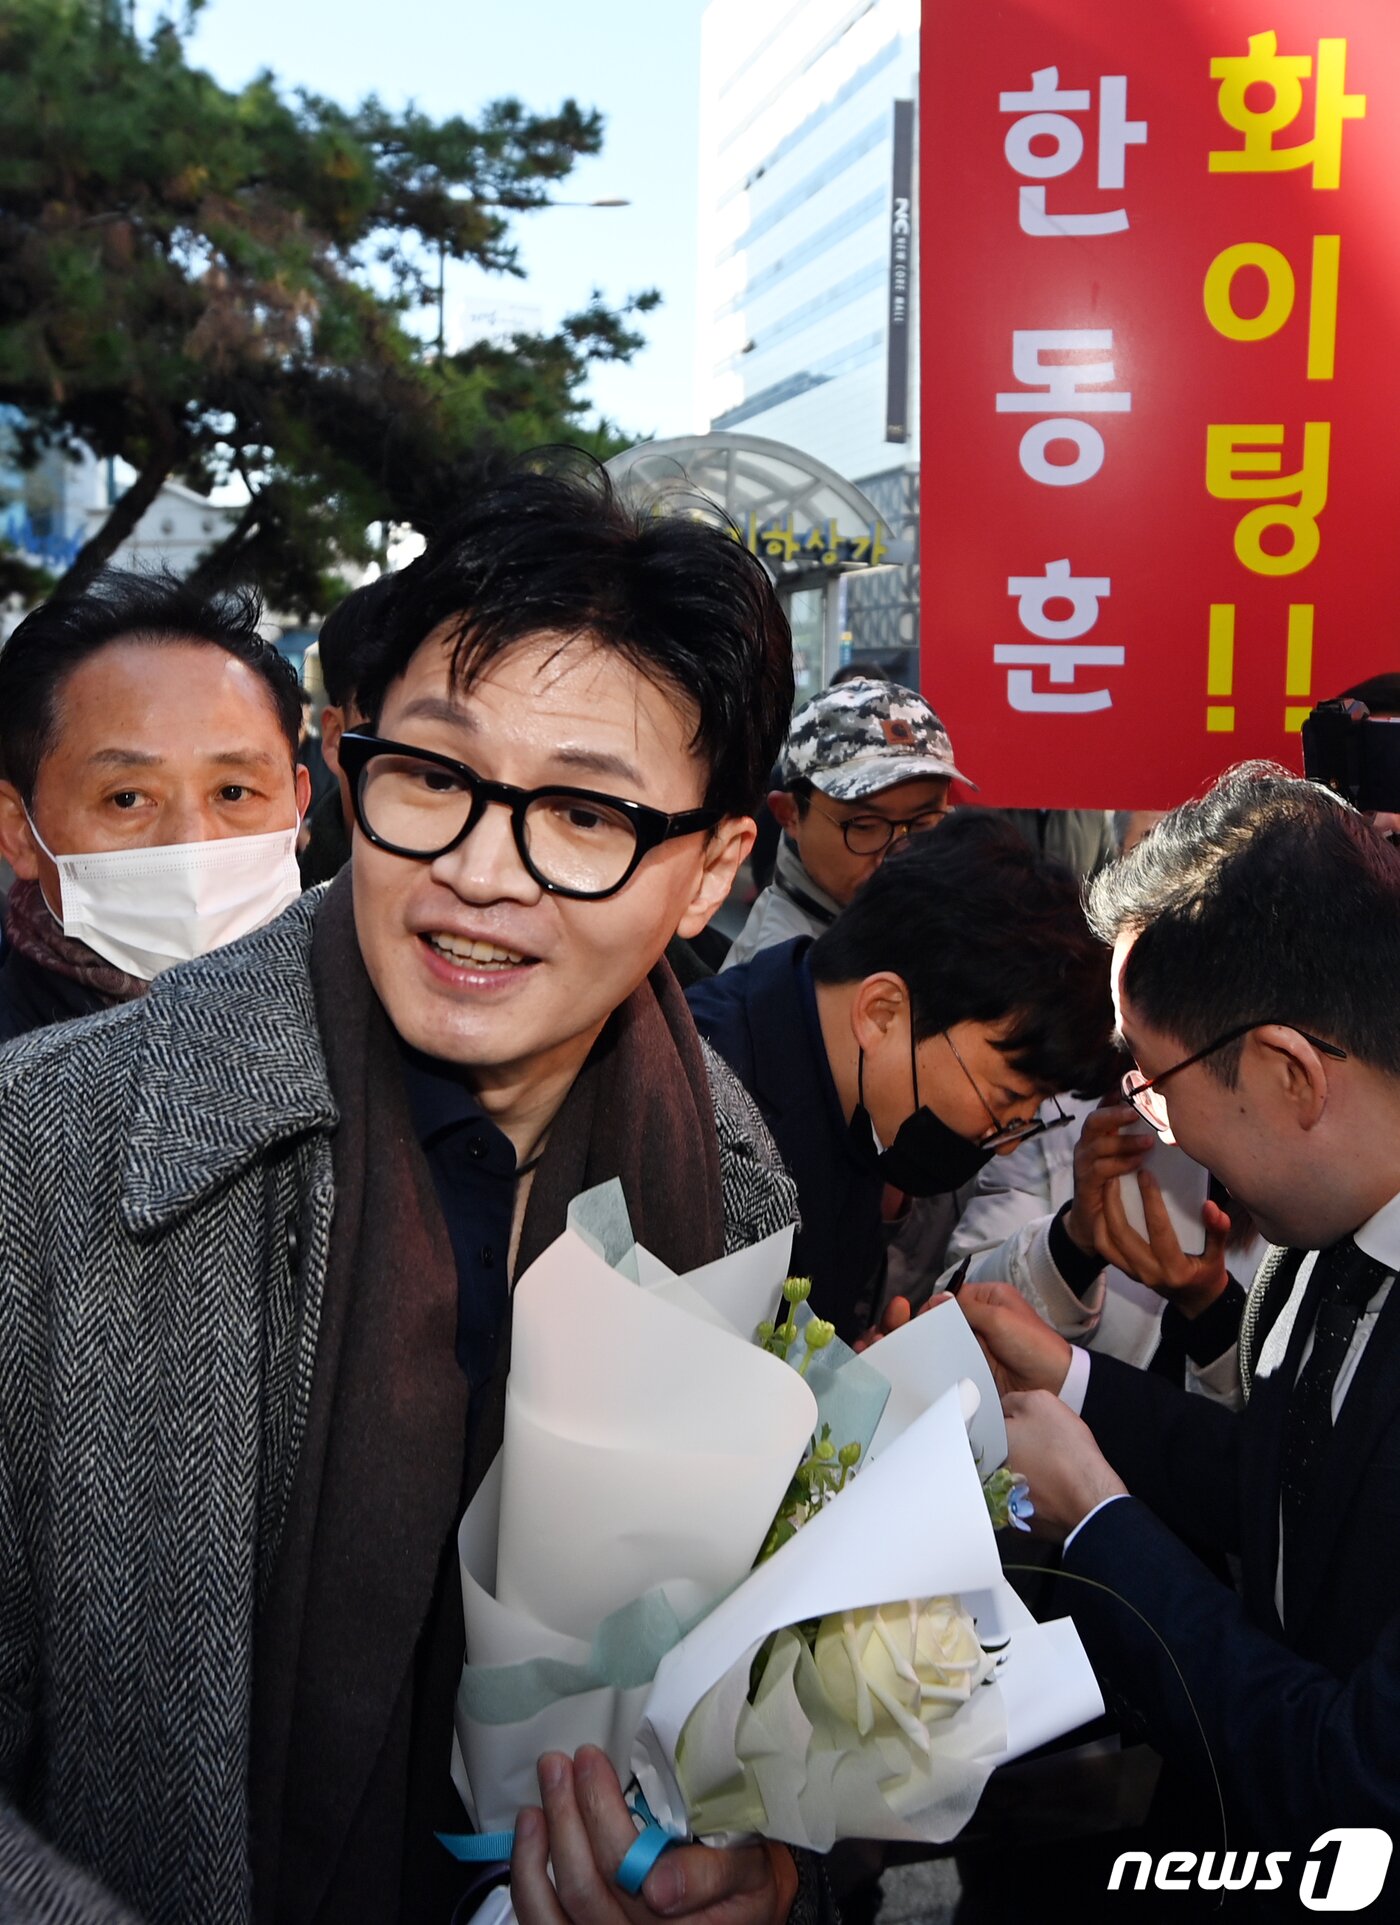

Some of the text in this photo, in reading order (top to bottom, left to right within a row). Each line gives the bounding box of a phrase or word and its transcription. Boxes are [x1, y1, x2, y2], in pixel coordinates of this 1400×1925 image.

[893, 197, 910, 236] NC
[895, 237, 907, 260] NEW
[894, 264, 907, 291] CORE
[995, 67, 1146, 711] 한동훈
[1204, 31, 1367, 731] 화이팅!!
[724, 510, 889, 566] 하상가
